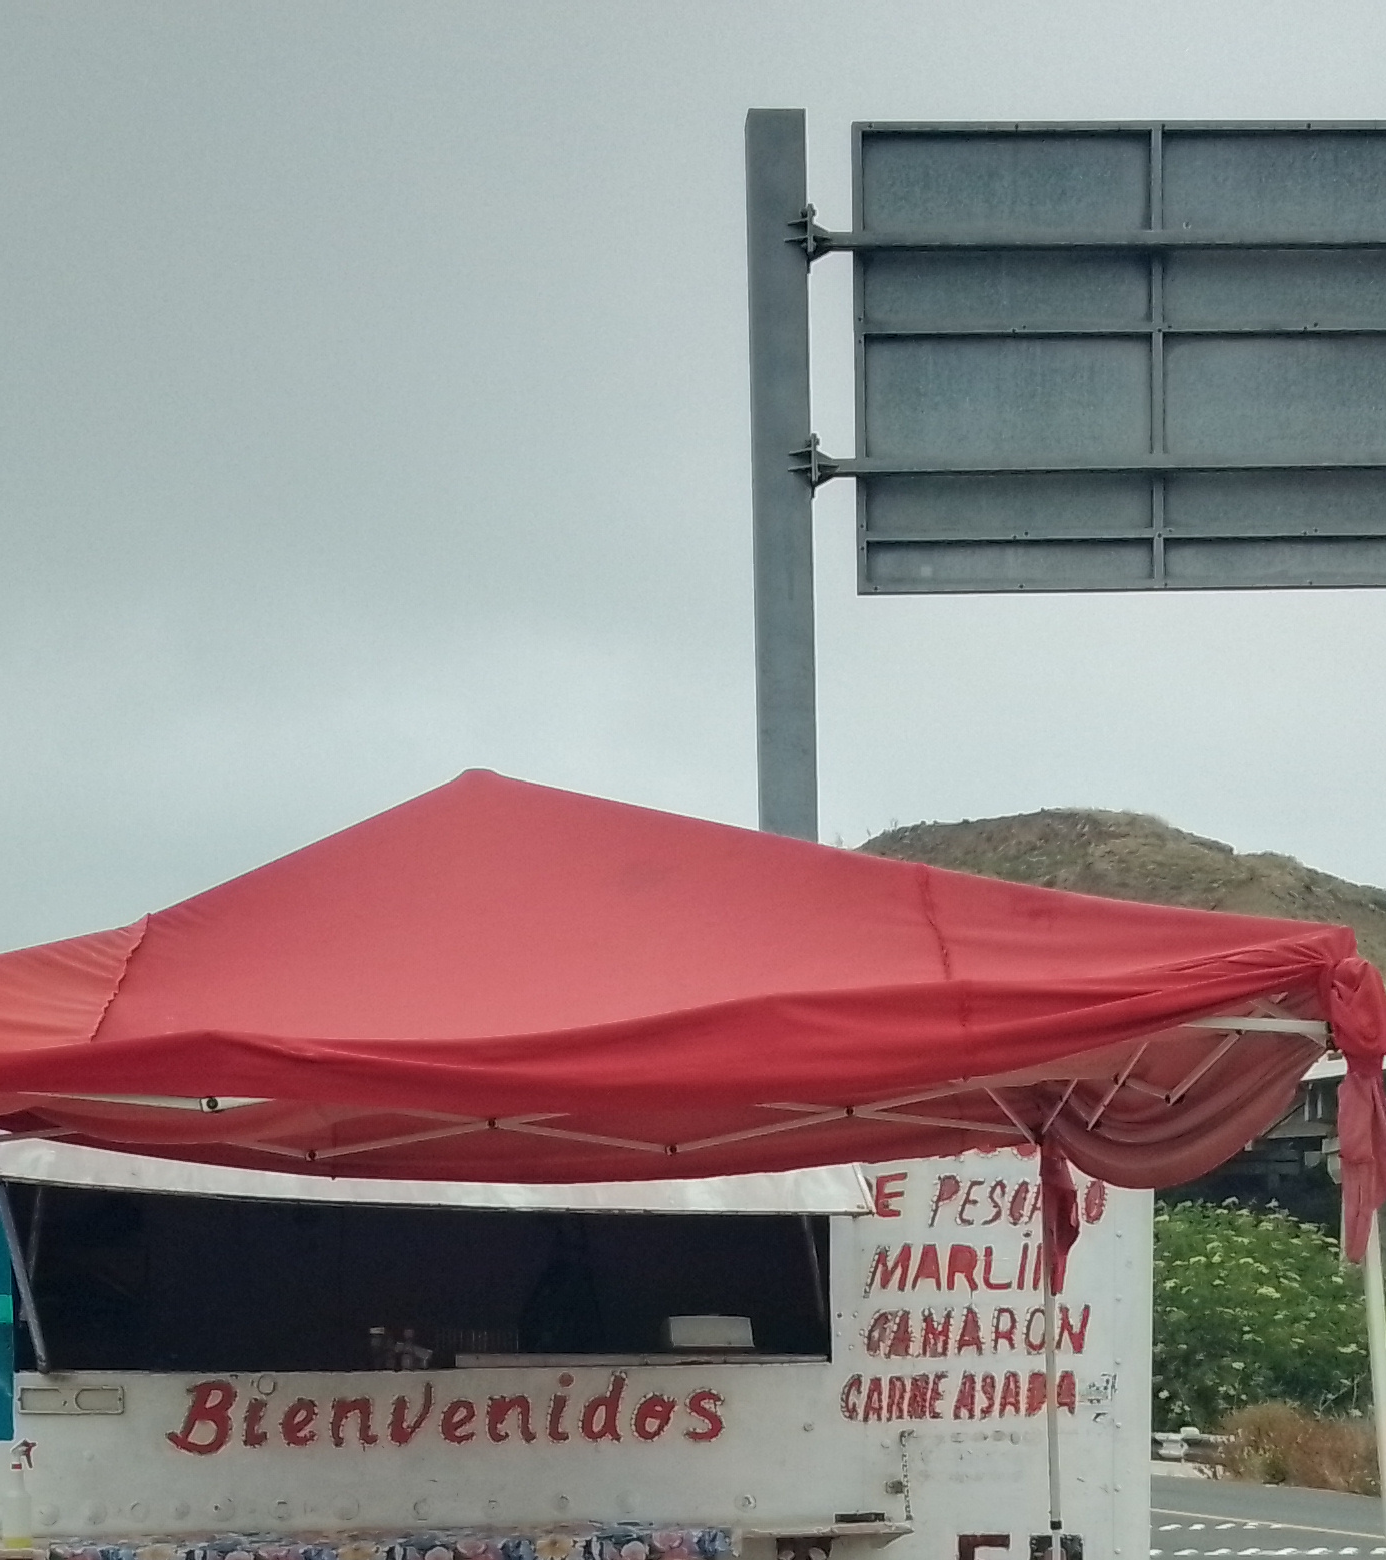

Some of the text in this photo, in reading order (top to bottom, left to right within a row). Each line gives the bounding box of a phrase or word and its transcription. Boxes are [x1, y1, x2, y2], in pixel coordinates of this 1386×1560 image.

[165, 1371, 725, 1455] Bienvenidos
[841, 1370, 1077, 1423] CARNE ASADA
